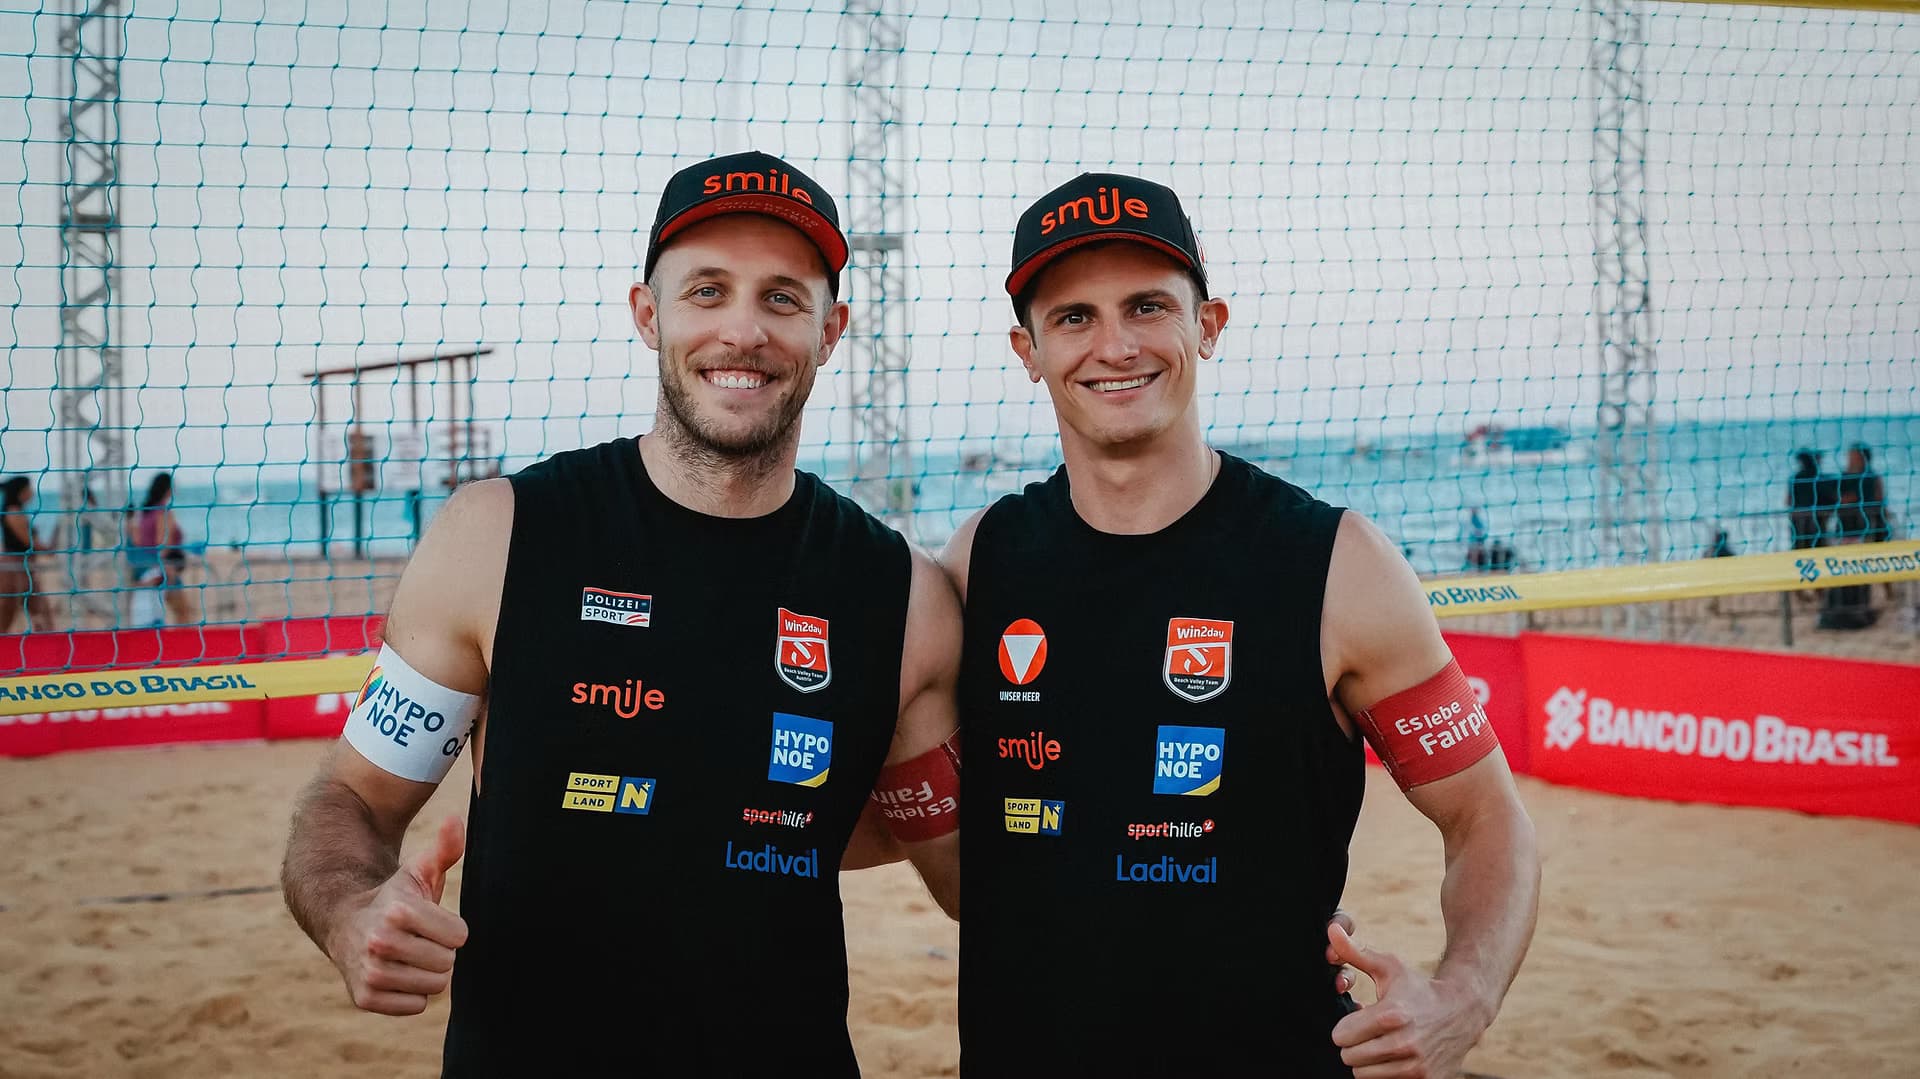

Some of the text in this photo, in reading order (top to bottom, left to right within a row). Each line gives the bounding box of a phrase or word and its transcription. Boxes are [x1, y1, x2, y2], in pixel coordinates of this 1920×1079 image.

[703, 169, 813, 206] smile
[1041, 187, 1149, 235] smile
[1825, 557, 1890, 576] BANCO
[1890, 555, 1915, 571] DO
[586, 594, 639, 610] POLIZEI
[1446, 585, 1524, 604] BRASIL
[585, 608, 625, 621] SPORT
[0, 675, 256, 701] ANCO DO BRASIL
[571, 679, 665, 719] smile
[999, 691, 1041, 702] UNSER HEER
[377, 680, 445, 732] HYPO
[366, 702, 416, 748] NOE
[1395, 701, 1462, 736] Es lebe
[1419, 703, 1488, 756] Fairpl
[775, 729, 830, 754] HYPO
[1588, 698, 1900, 767] BANCO DO BRASIL
[773, 747, 815, 770] NOE
[998, 731, 1061, 770] smile
[1159, 741, 1221, 762] HYPO
[1157, 760, 1203, 779] NOE
[574, 777, 613, 789] SPORT
[871, 780, 934, 808] Fair
[572, 796, 605, 808] LAND
[883, 796, 957, 820] Es lebe
[1007, 803, 1036, 811] SPORT
[743, 808, 806, 829] sporthilfe
[1008, 820, 1031, 830] LAND
[1127, 821, 1203, 841] sporthilfe
[725, 840, 819, 879] Ladival
[1116, 854, 1217, 884] Ladival
